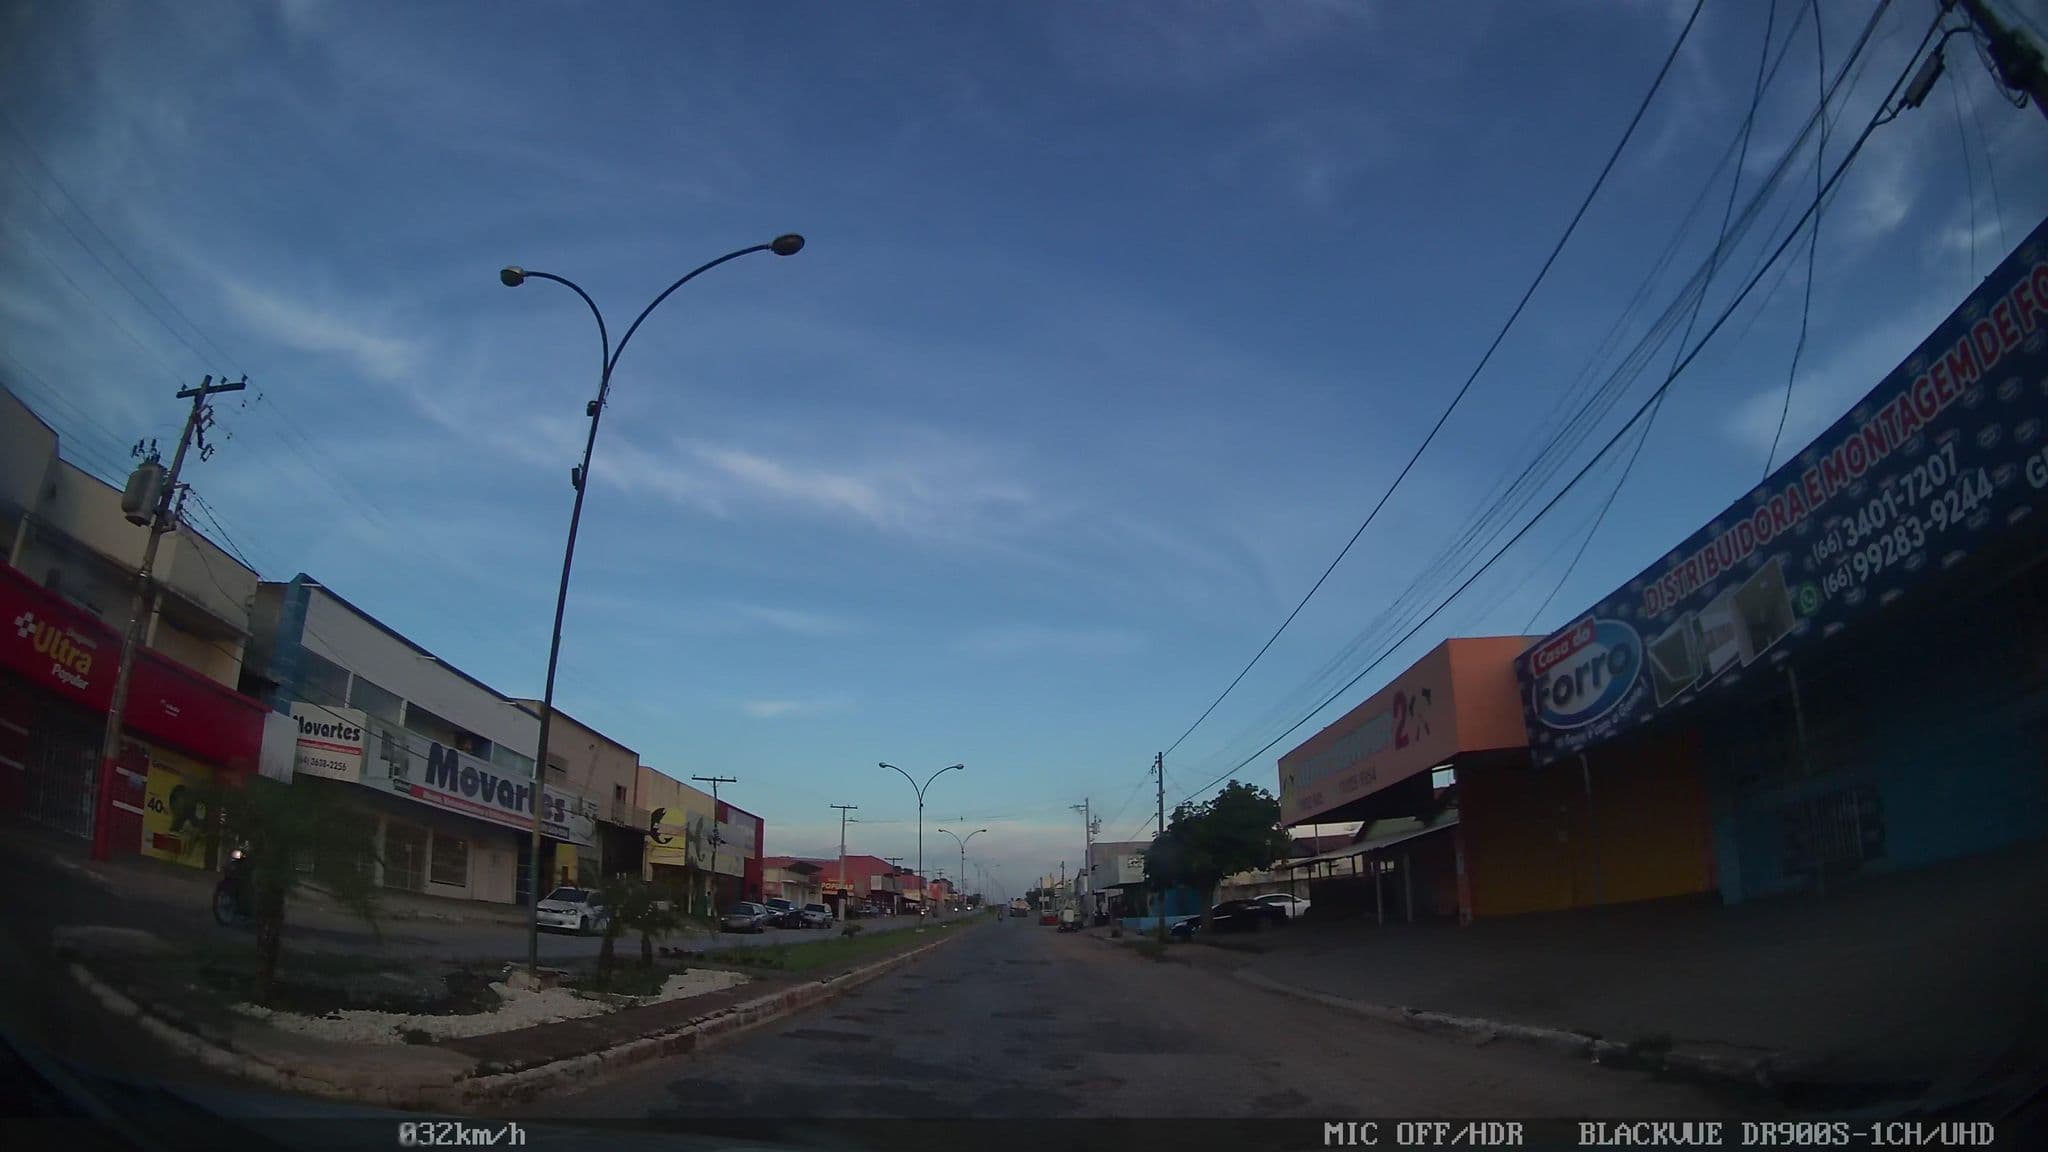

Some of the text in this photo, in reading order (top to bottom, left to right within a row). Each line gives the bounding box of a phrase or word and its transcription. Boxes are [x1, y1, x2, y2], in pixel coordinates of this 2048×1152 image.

[1644, 484, 1806, 617] DISTRIBUIDORA
[1802, 465, 1826, 512] E
[1820, 335, 1980, 498] MONTAGEM
[1972, 297, 2022, 369] DE
[2025, 446, 2048, 489] G
[1812, 443, 1957, 565] (66) 3401-7207
[1823, 467, 1993, 600] (66) 99283-9244
[33, 620, 92, 675] Ultra
[1537, 640, 1570, 667] Casa
